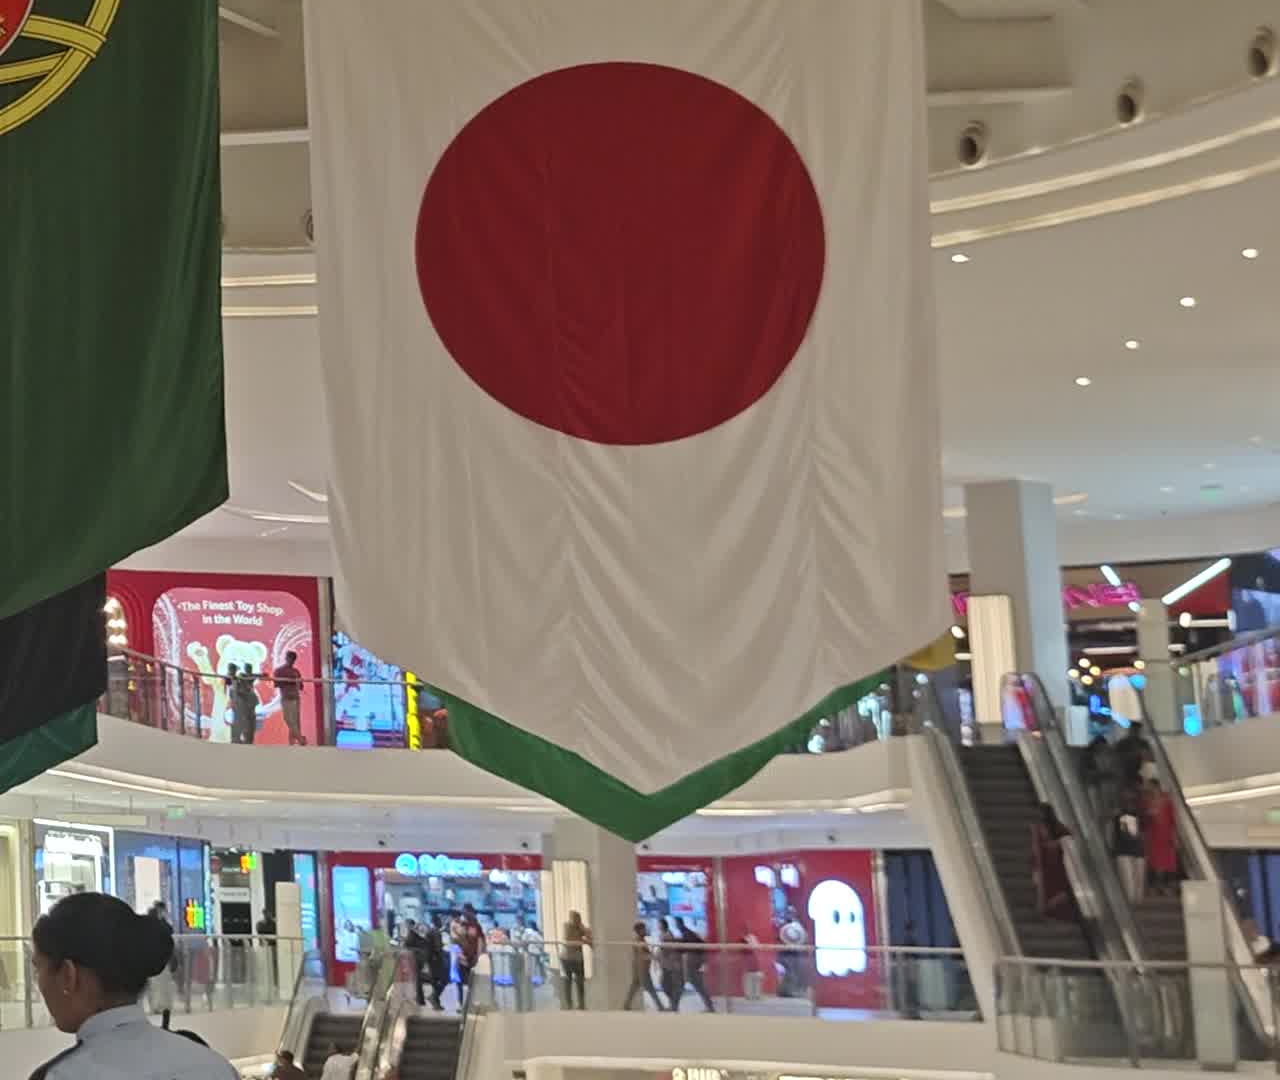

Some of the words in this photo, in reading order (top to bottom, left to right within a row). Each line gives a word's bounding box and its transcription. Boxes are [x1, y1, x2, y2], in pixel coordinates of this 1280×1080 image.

[203, 600, 235, 611] Finest
[237, 600, 254, 613] Toy
[214, 614, 231, 625] the
[233, 614, 262, 627] World
